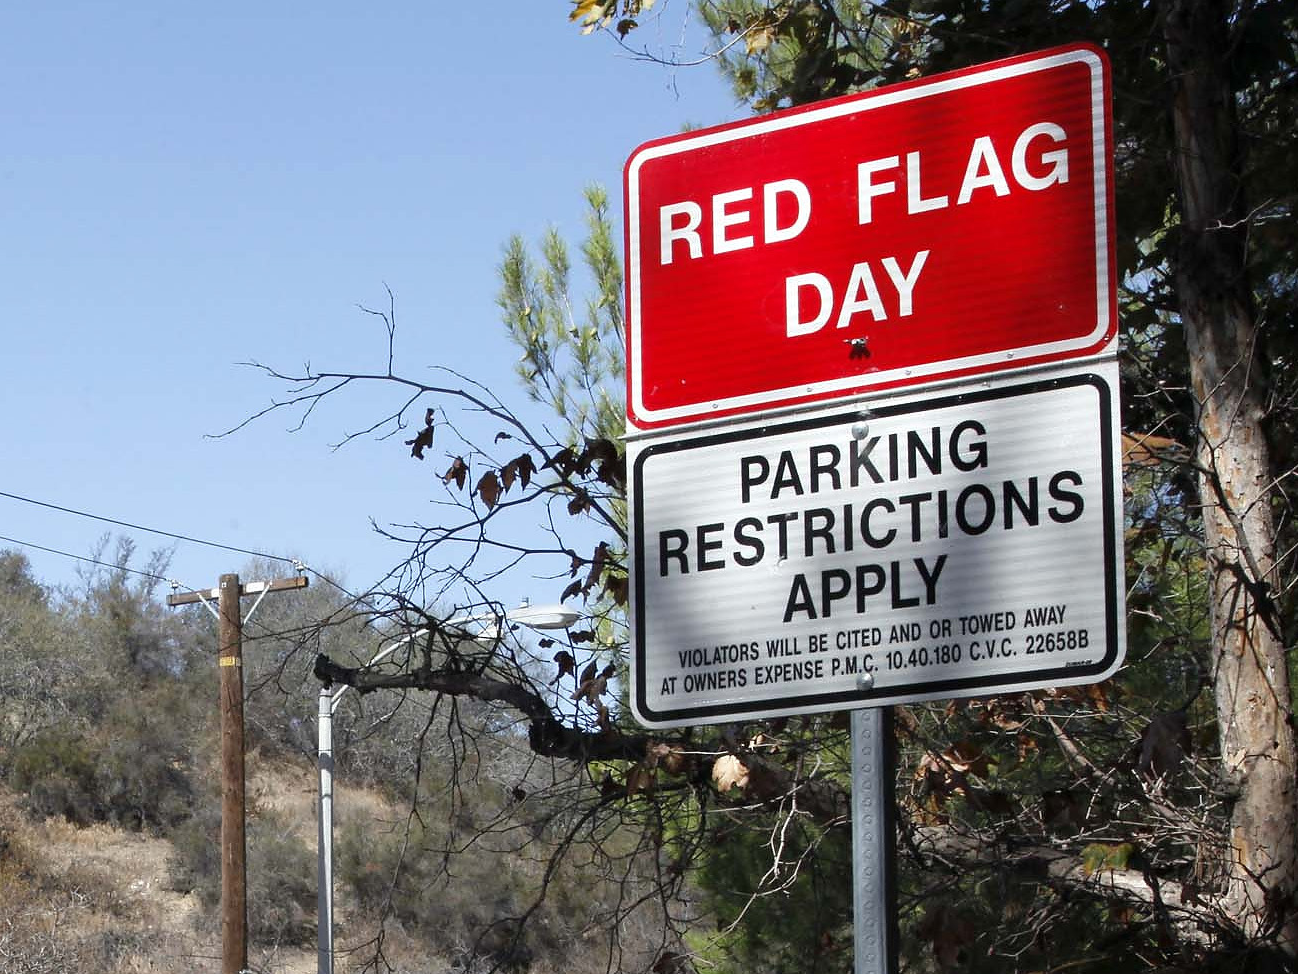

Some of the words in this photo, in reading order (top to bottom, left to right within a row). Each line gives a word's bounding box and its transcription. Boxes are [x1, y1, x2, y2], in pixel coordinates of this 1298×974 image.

[659, 178, 812, 266] RED
[857, 121, 1070, 225] FLAG
[785, 249, 930, 338] DAY
[740, 419, 989, 504] PARKING
[659, 470, 1086, 578] RESTRICTIONS
[783, 553, 949, 623] APPLY
[660, 676, 678, 696] AT
[683, 668, 748, 693] OWNERS
[754, 659, 823, 685] EXPENSE
[831, 653, 879, 676] P.M.C.
[885, 643, 962, 670] 10.40.180
[969, 637, 1017, 662] C.V.C.
[1025, 629, 1090, 655] 22658B
[678, 641, 759, 669] VIOLATORS
[766, 637, 802, 659] WILL
[808, 633, 828, 653] BE
[836, 627, 882, 650] CITED
[889, 622, 922, 644] AND
[929, 618, 952, 640] OR
[959, 611, 1016, 636] TOWED
[1023, 604, 1066, 629] AWAY
